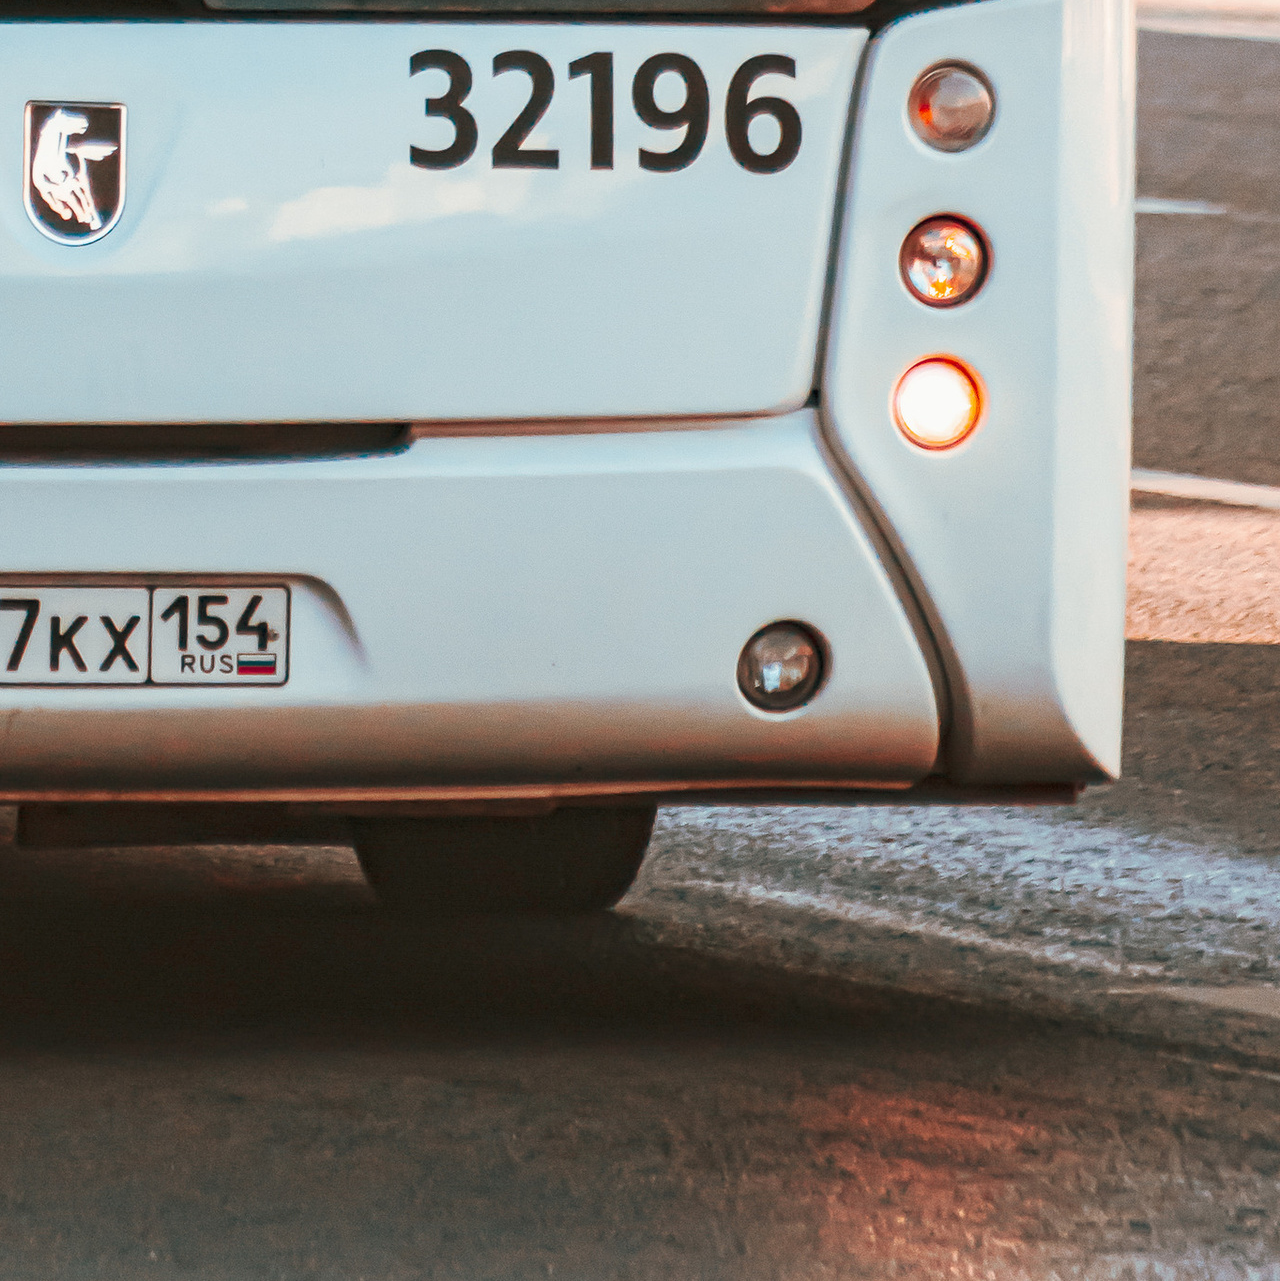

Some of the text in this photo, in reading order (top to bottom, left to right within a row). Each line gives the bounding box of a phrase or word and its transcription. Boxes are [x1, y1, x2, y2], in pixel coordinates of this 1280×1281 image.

[409, 48, 803, 175] 32196
[160, 594, 271, 652] 154
[180, 653, 235, 674] RUS
